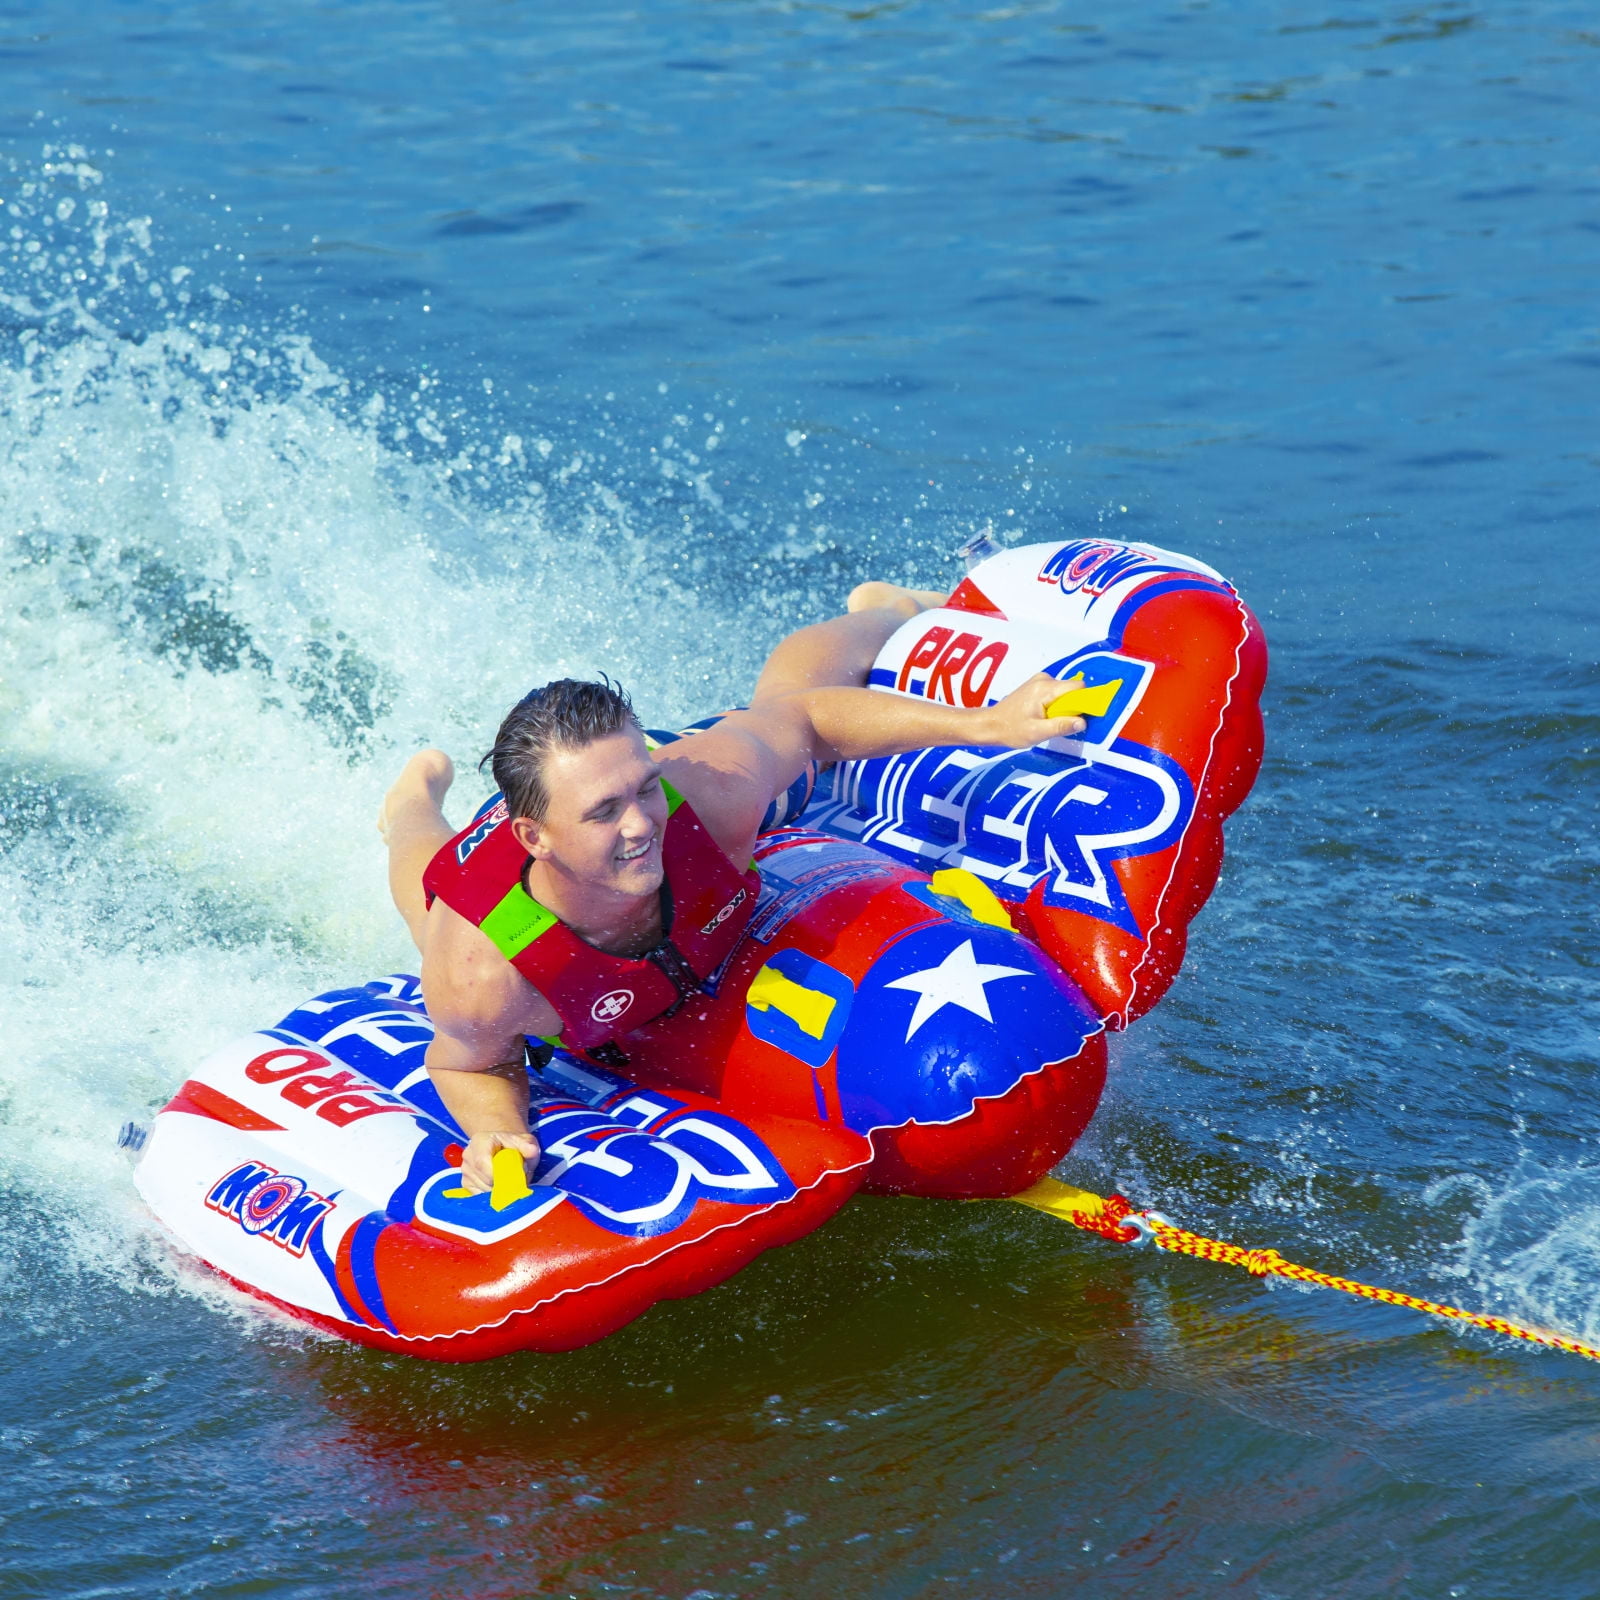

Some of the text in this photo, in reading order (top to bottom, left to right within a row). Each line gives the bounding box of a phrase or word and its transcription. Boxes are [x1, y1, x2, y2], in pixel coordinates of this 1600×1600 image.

[1038, 538, 1158, 597] WOW
[899, 626, 1009, 707] PRO
[701, 888, 747, 935] WOW
[245, 1048, 419, 1128] PRO
[204, 1159, 338, 1259] WOW
